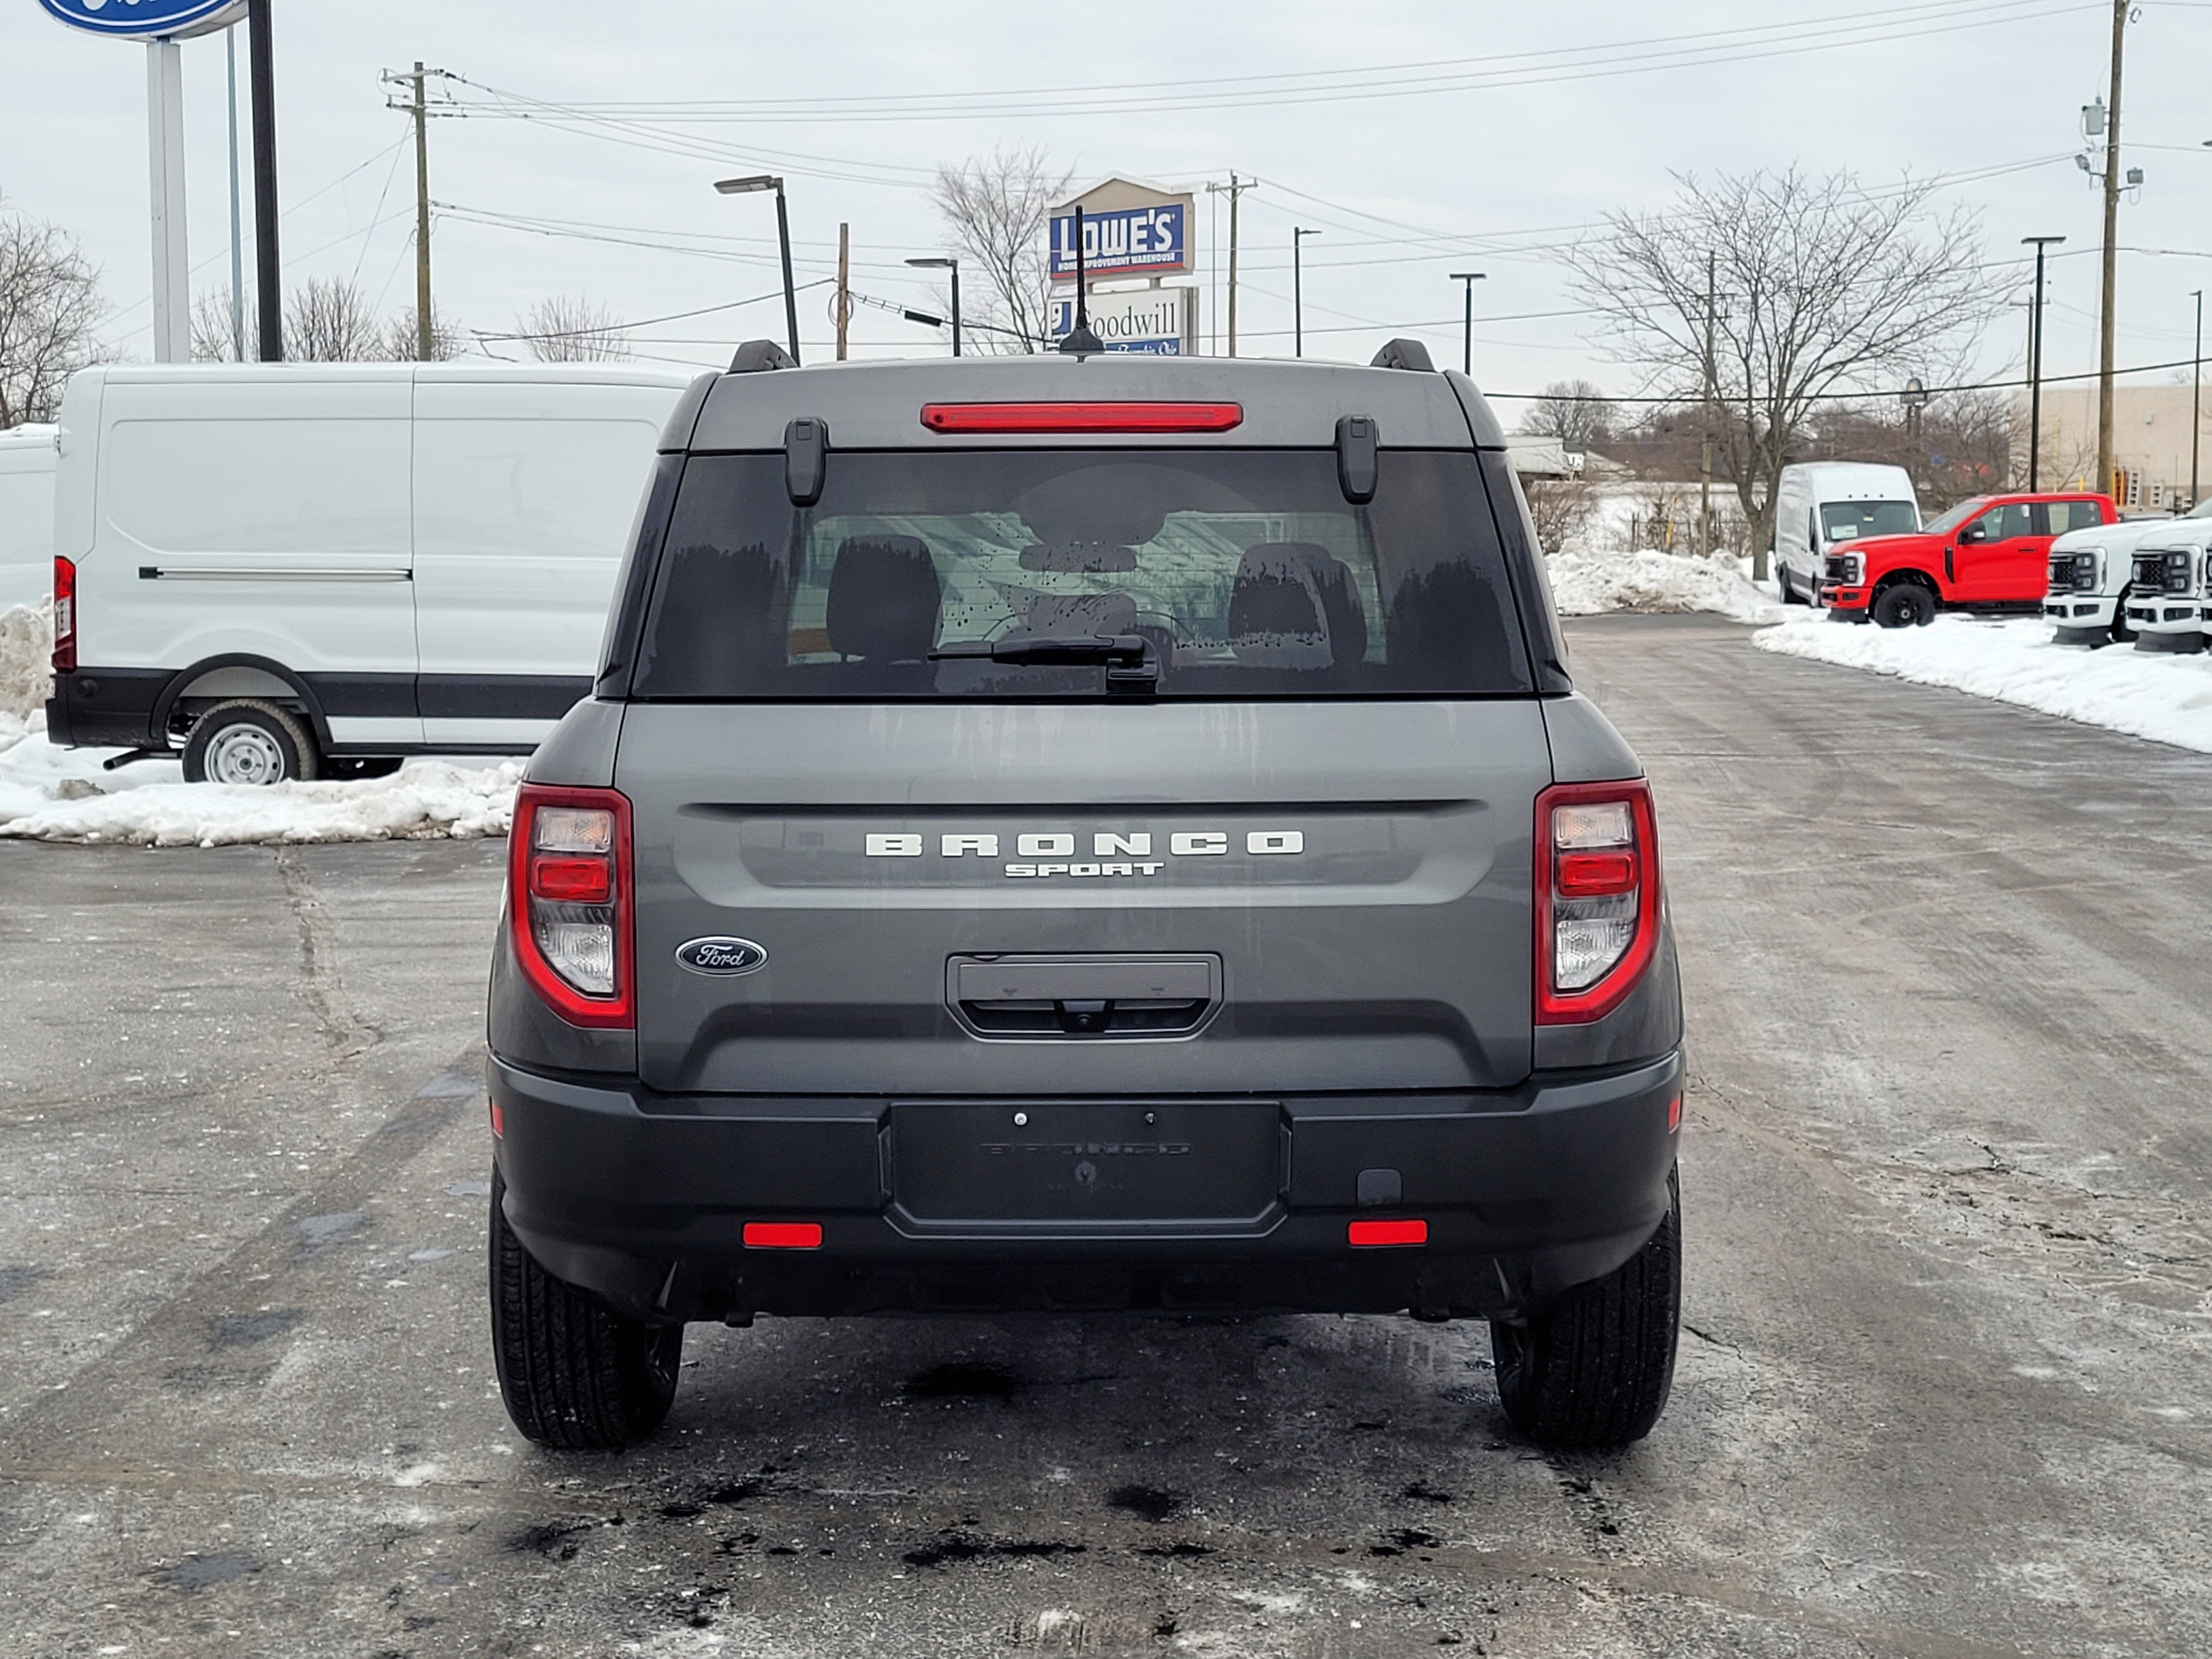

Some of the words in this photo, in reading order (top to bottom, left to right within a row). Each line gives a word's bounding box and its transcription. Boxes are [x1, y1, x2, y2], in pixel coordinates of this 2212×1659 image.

[1060, 208, 1172, 261] LOWE'S
[1083, 256, 1130, 269] MPROVEMENT
[1085, 303, 1176, 337] oodwill
[865, 831, 1304, 857] BRONCO
[1005, 862, 1164, 877] SPORT
[696, 944, 744, 966] Ford
